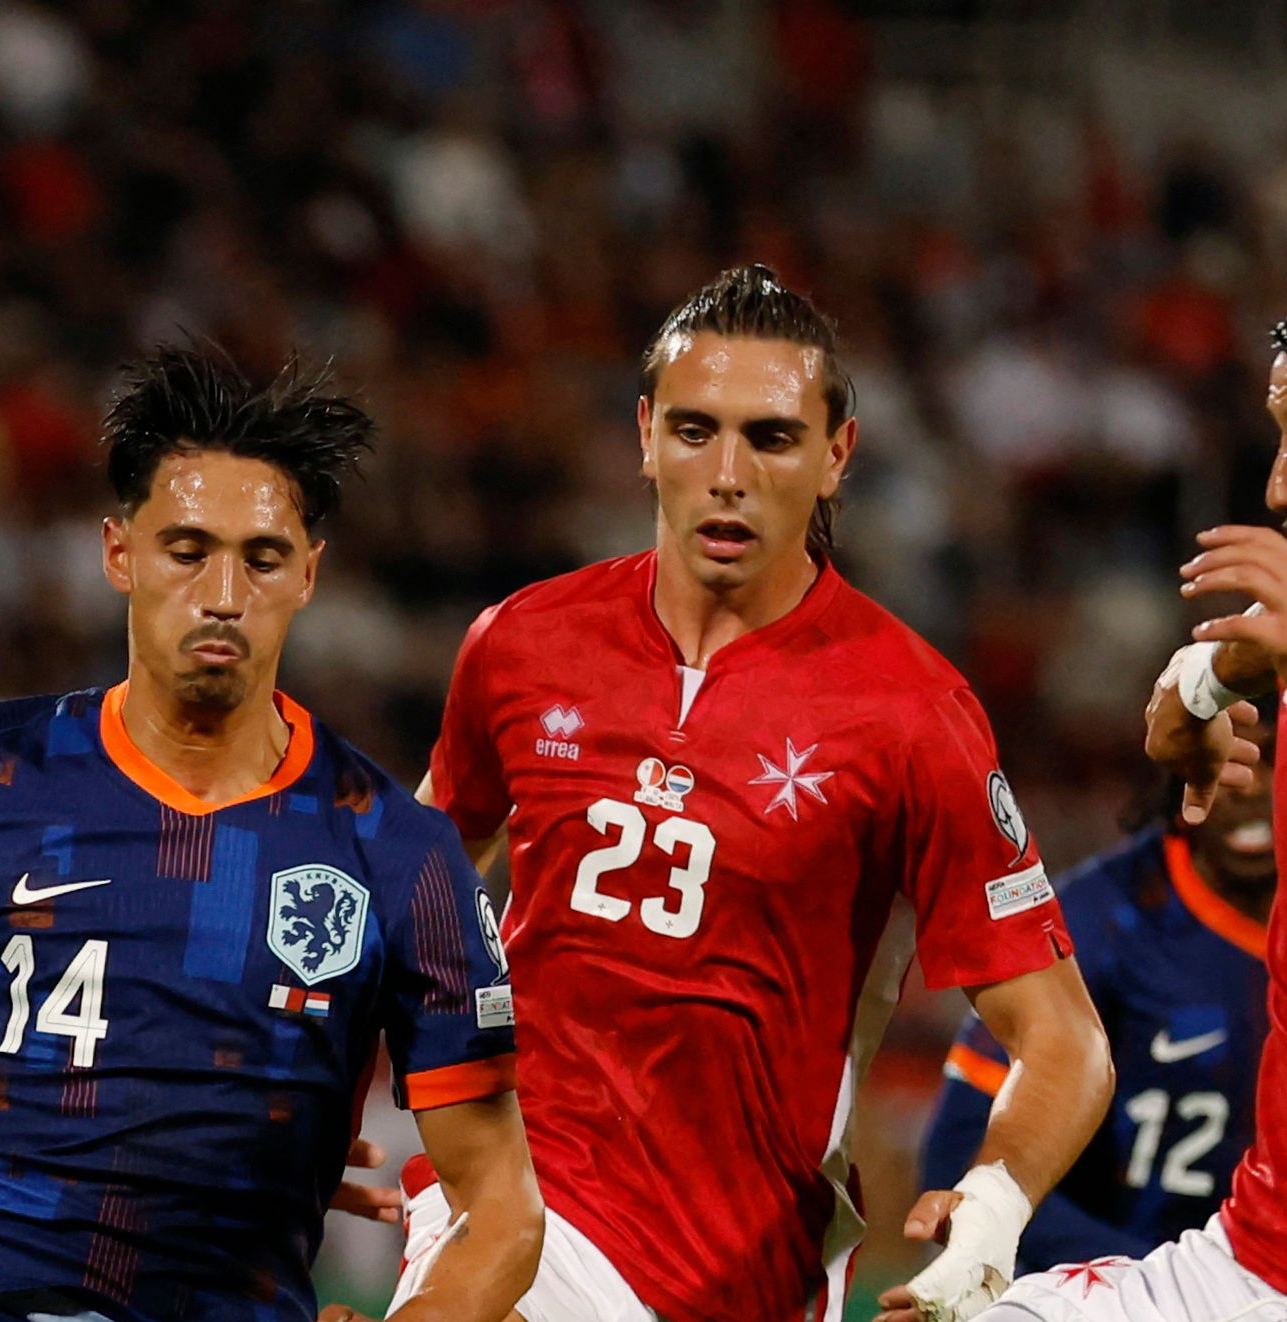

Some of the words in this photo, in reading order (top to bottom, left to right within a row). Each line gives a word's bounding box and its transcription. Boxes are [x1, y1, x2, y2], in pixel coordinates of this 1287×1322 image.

[536, 738, 580, 761] errea
[570, 797, 716, 939] 23
[1125, 1088, 1230, 1197] 12
